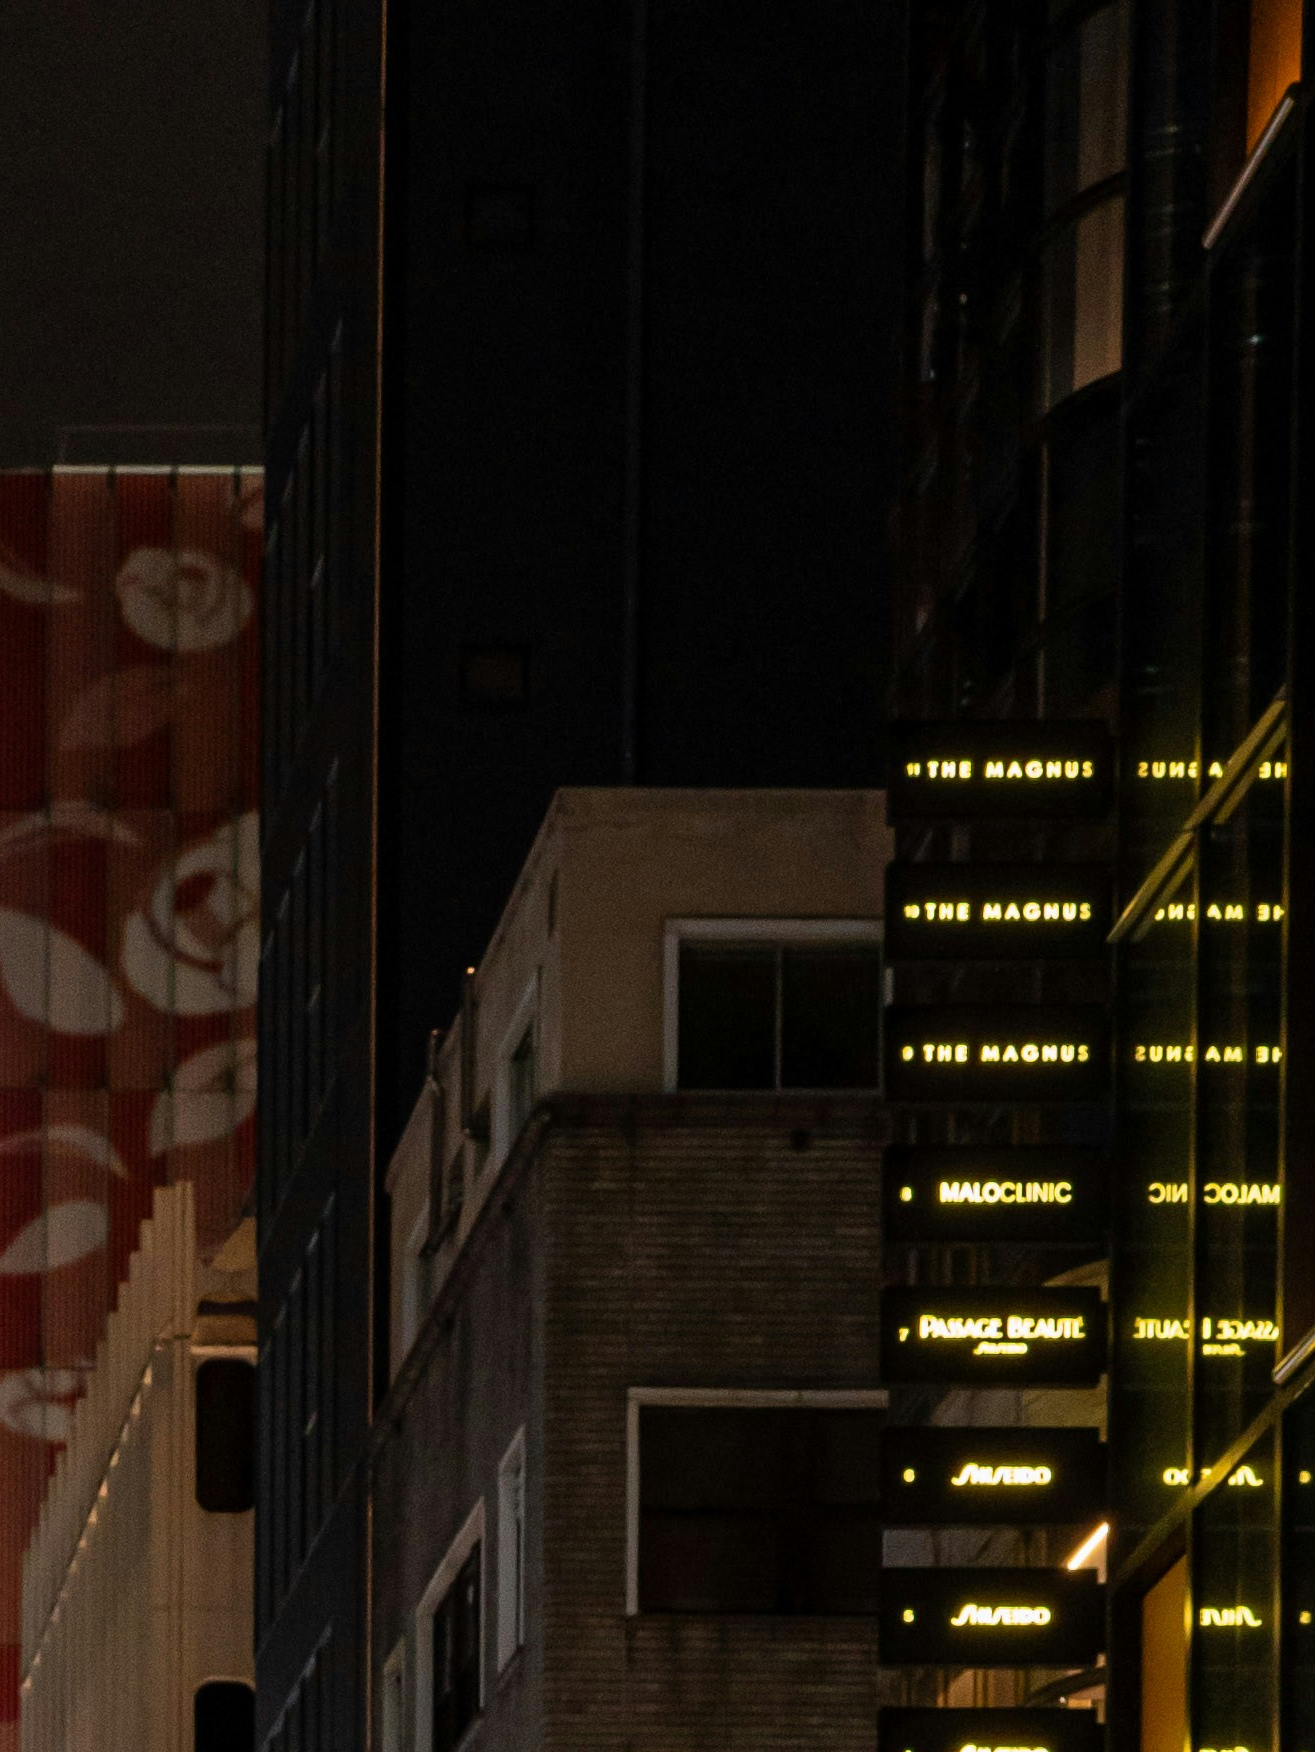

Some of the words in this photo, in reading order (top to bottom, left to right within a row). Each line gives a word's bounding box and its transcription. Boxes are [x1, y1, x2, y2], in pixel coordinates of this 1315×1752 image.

[927, 760, 973, 779] THE
[985, 759, 1094, 779] MAGNUS
[925, 902, 971, 922] THE
[982, 901, 1092, 922] MAGNUS
[923, 1044, 969, 1063] THE
[980, 1043, 1090, 1063] MAGNUS
[938, 1181, 1074, 1205] MALOCLINIC
[950, 1461, 1054, 1487] SHISEIDO
[950, 1602, 1053, 1627] SHISEIDO
